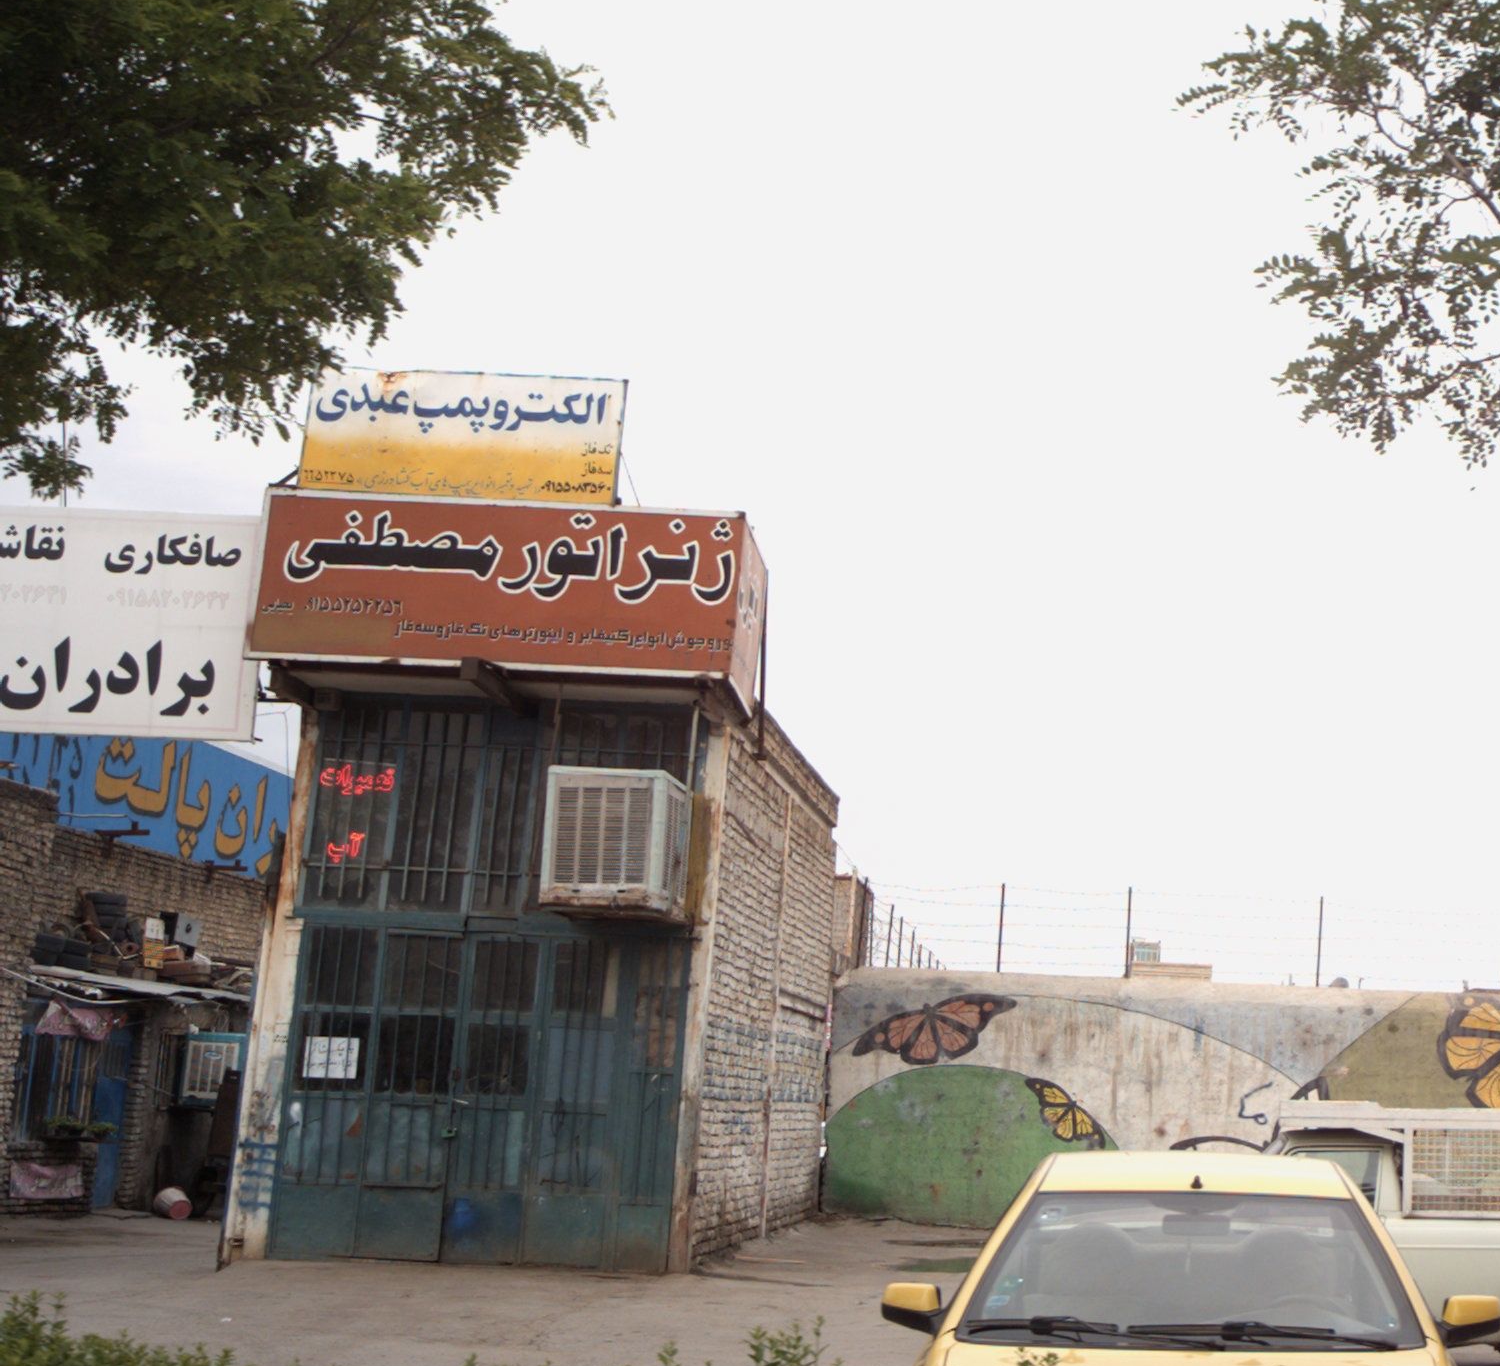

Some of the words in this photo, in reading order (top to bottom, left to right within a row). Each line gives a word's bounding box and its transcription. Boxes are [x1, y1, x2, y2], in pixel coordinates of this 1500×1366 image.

[315, 383, 409, 422] عبدی
[580, 441, 598, 457] فاز
[580, 461, 598, 477] فاز
[0, 524, 65, 561] نقاش
[104, 533, 242, 575] صافکاری
[283, 510, 503, 583] مصطفی
[498, 512, 735, 606] ژنراتور
[0, 636, 216, 717] برادران
